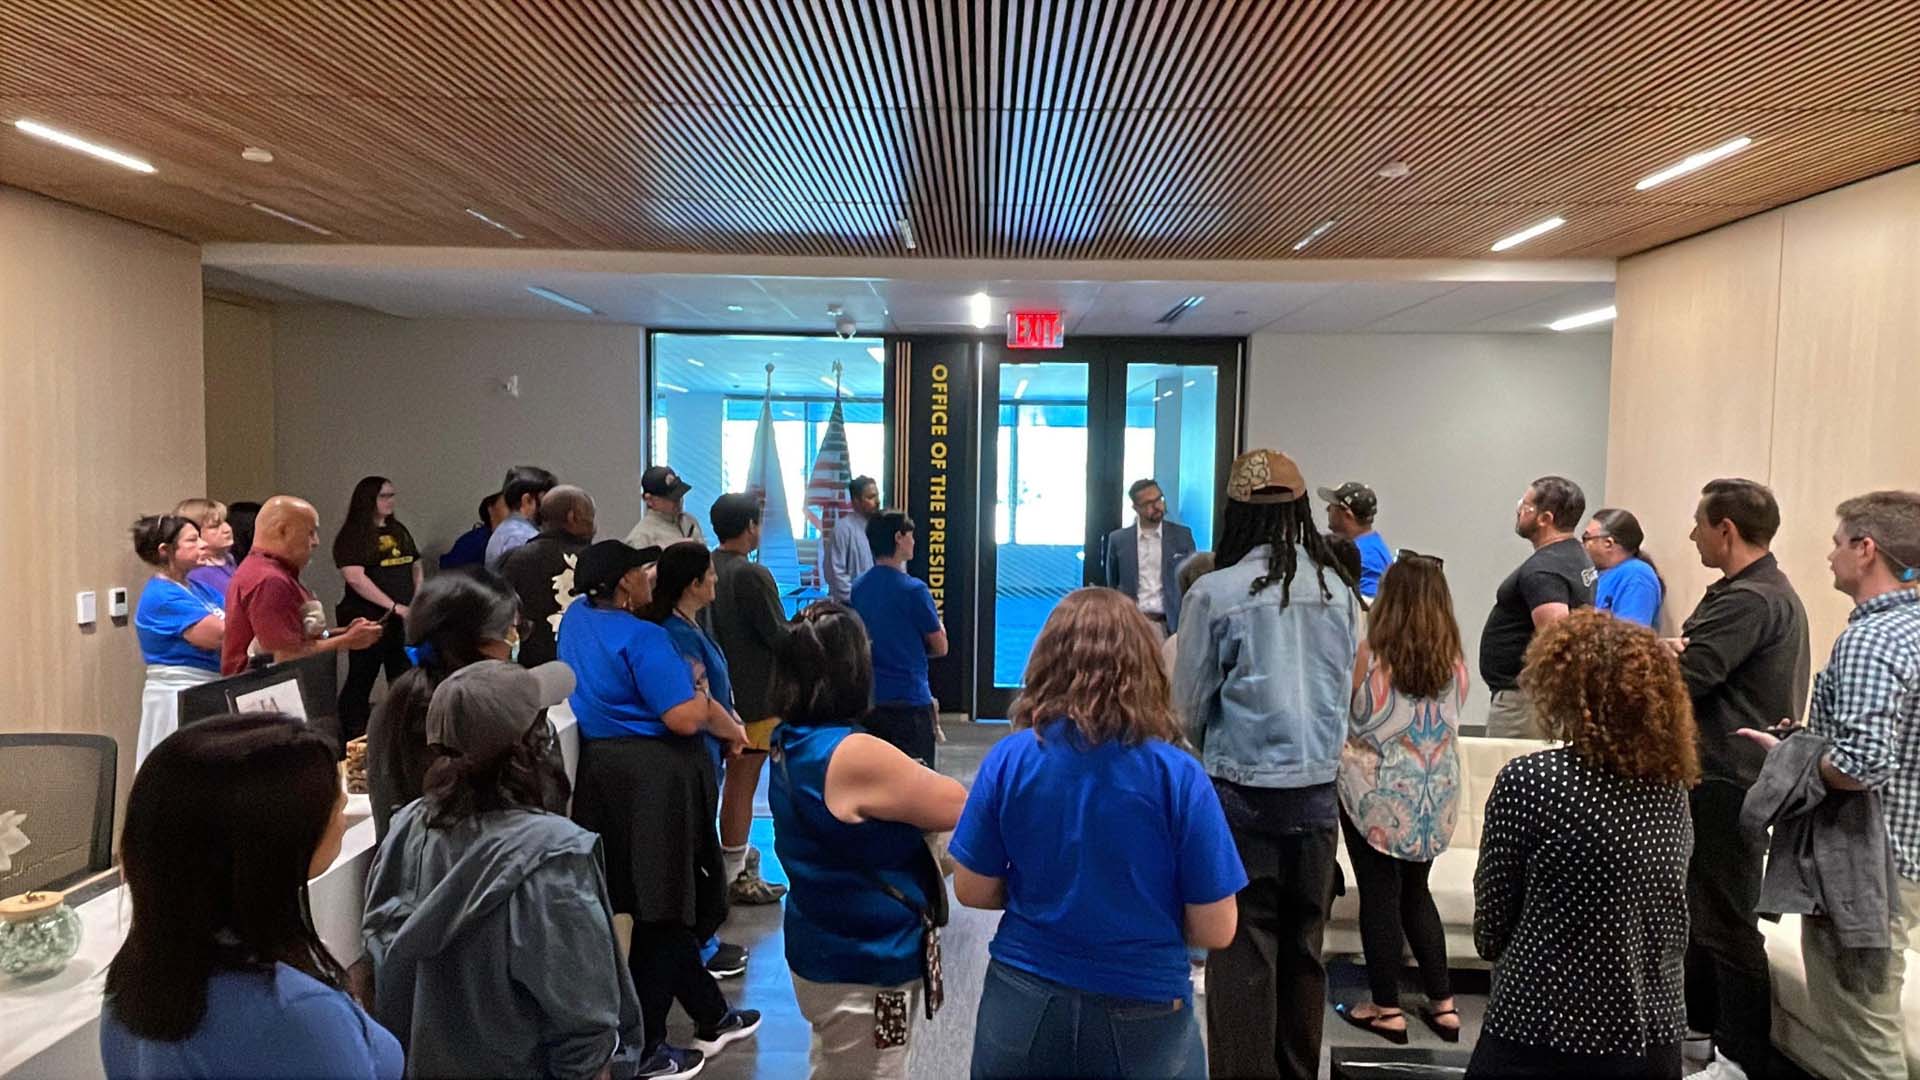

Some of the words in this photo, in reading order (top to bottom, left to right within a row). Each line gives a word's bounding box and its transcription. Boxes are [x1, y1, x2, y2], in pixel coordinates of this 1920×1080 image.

[1017, 315, 1058, 344] EXIT
[931, 364, 948, 436] OFFICE
[930, 442, 947, 469] OF
[930, 475, 947, 512] THE
